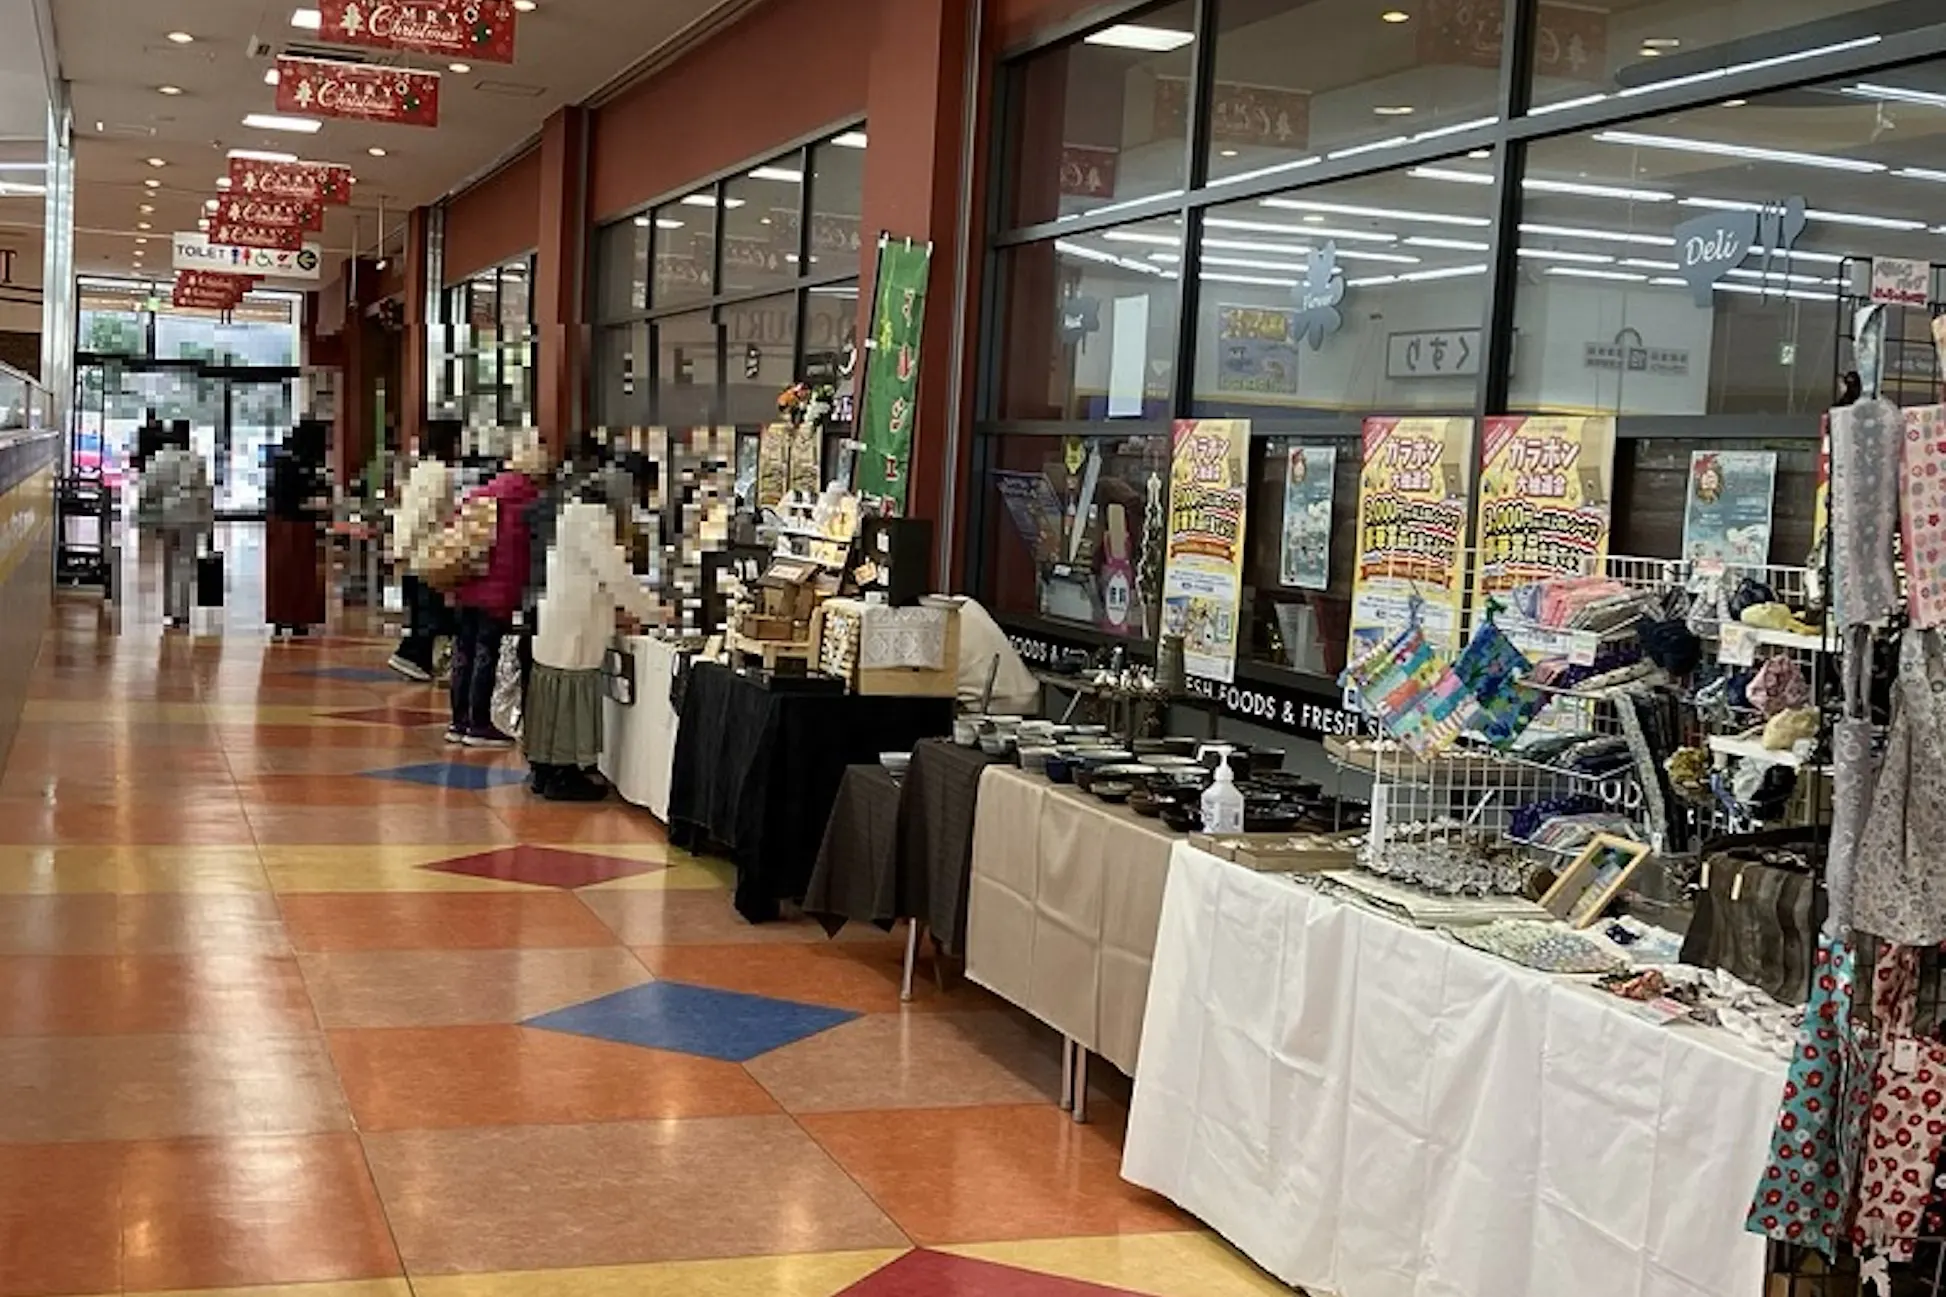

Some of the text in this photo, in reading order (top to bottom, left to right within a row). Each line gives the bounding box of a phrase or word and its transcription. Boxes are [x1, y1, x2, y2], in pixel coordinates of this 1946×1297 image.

[176, 243, 226, 260] TOILET
[1685, 228, 1740, 266] Deli
[1218, 683, 1276, 720] FOODS
[1281, 700, 1296, 725] &
[1300, 702, 1359, 736] FRESH
